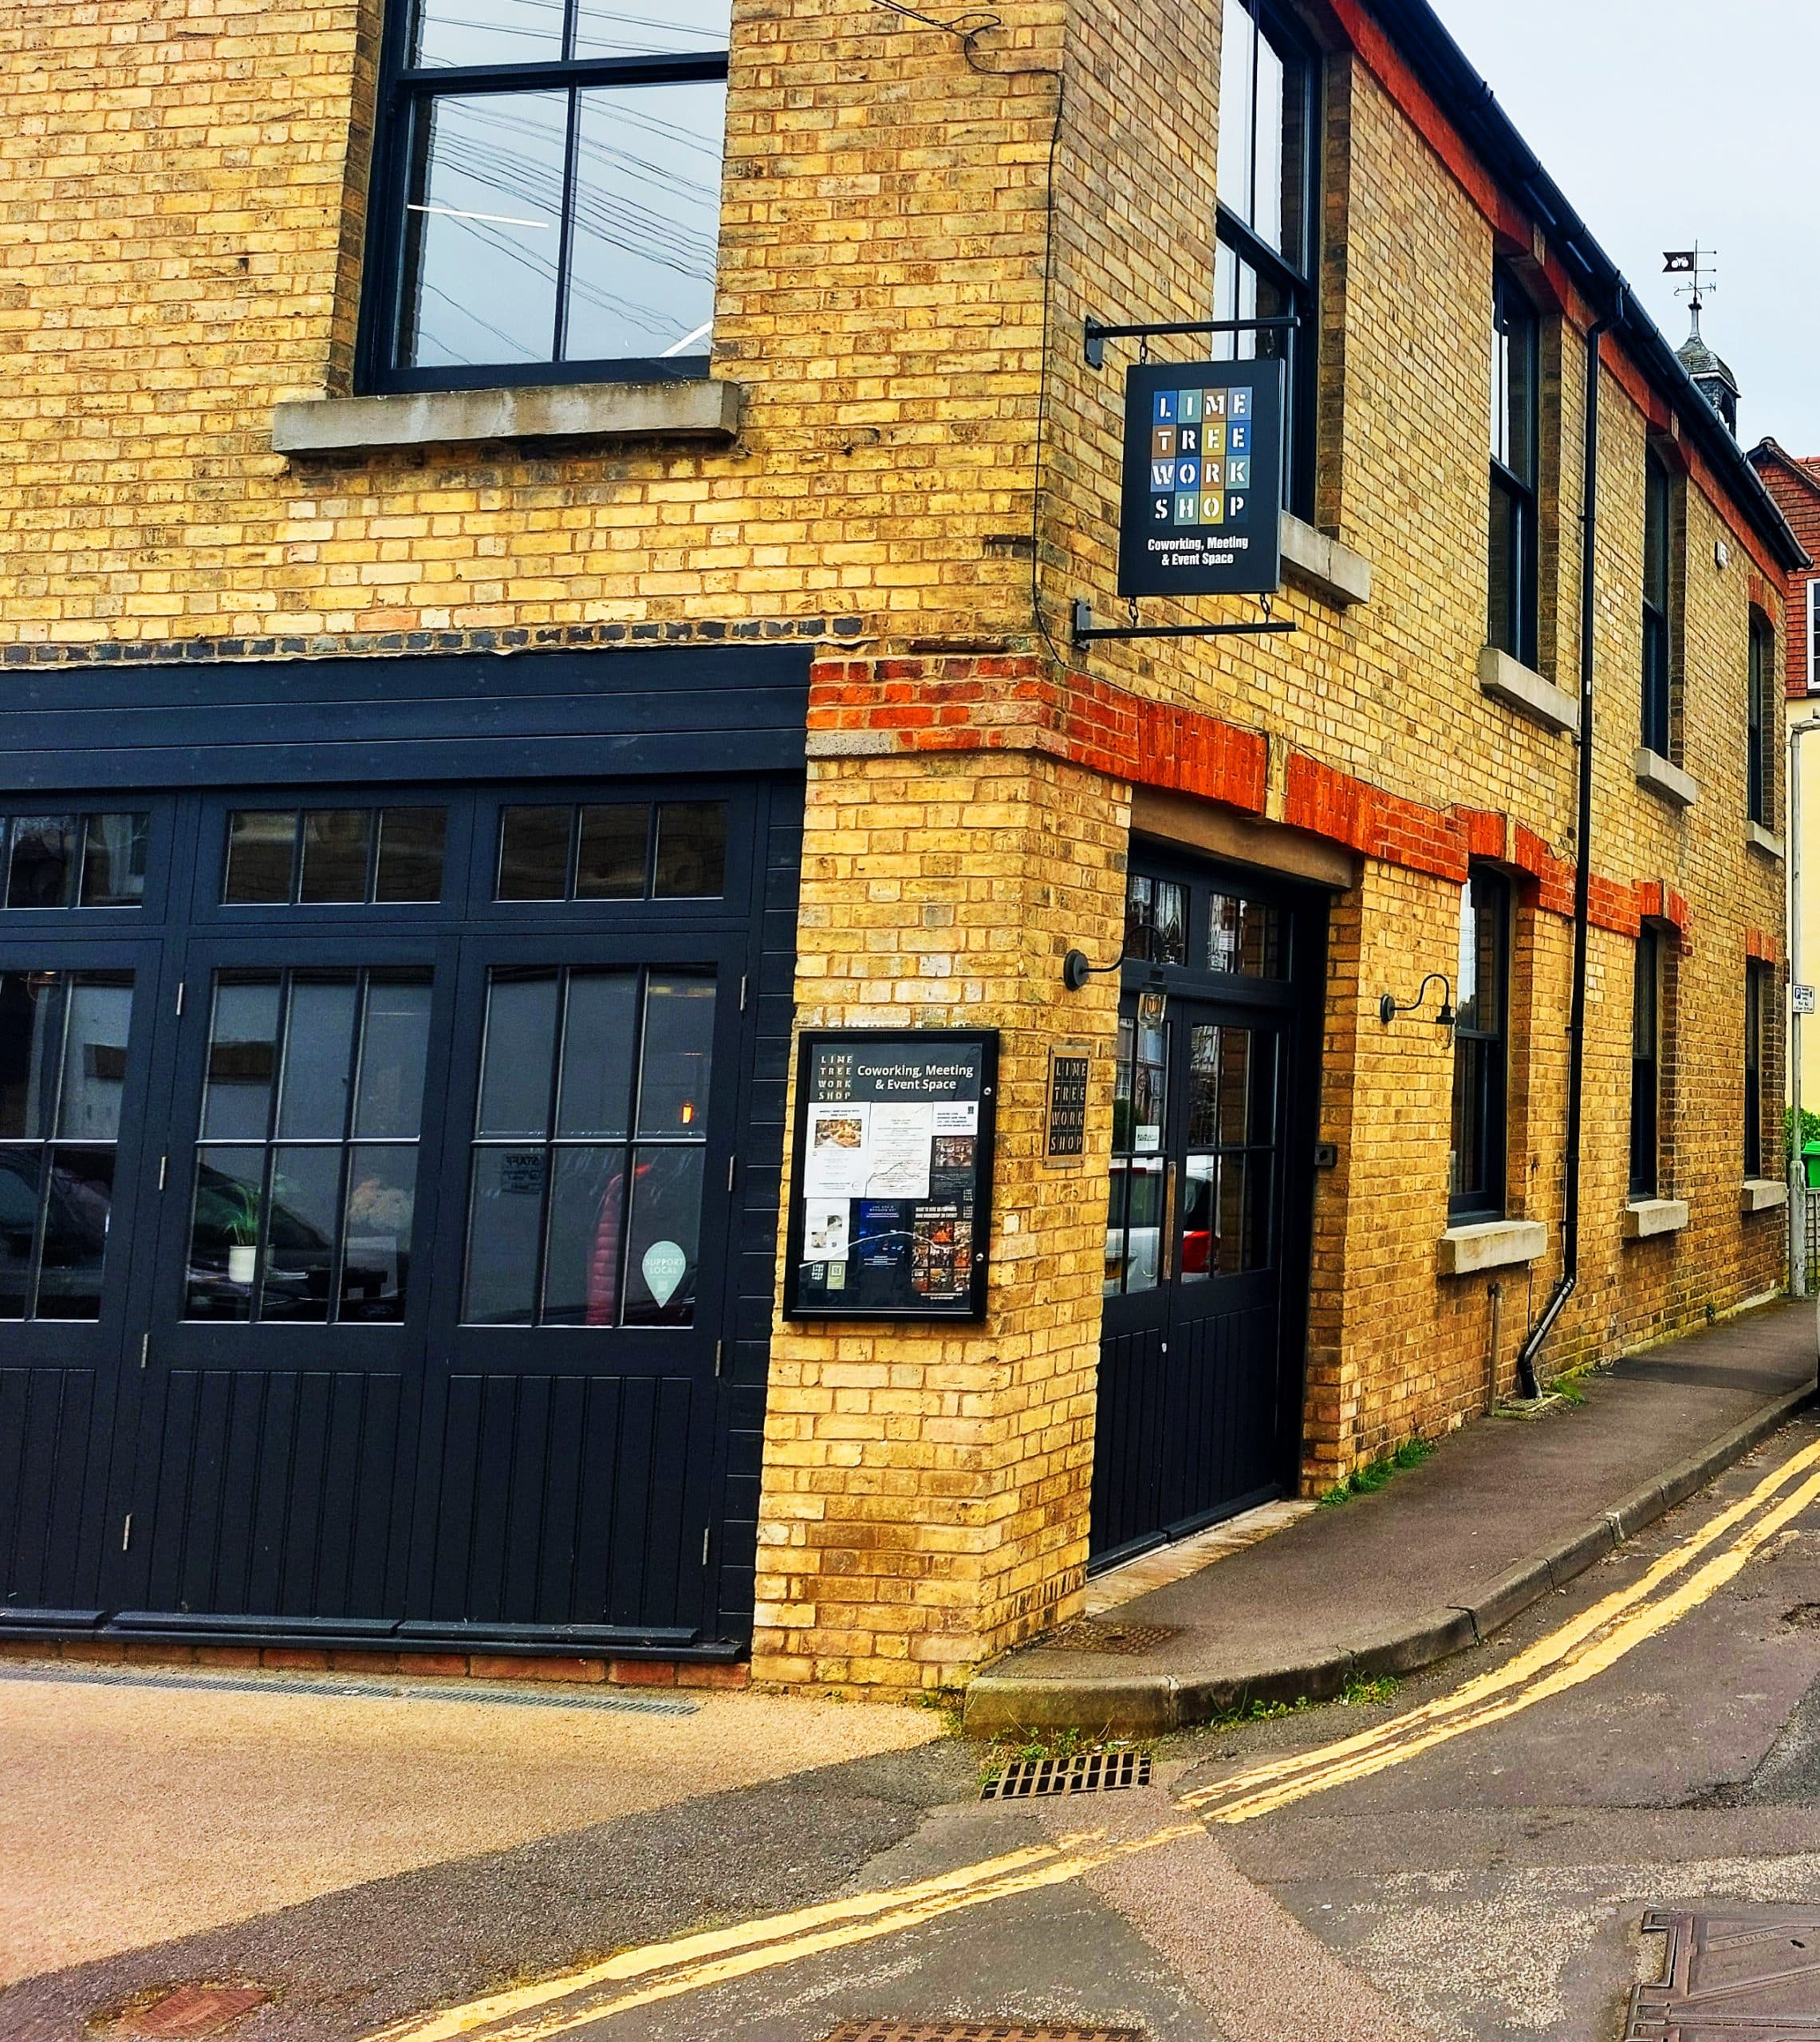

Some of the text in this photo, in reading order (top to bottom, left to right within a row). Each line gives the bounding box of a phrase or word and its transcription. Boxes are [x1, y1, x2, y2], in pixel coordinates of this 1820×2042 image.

[1159, 393, 1247, 418] LIME
[1157, 427, 1245, 451] TREE
[1151, 461, 1246, 486] WORK
[1154, 495, 1244, 519] SHOP
[1148, 535, 1248, 551] Coworking, Meeting
[1161, 552, 1234, 566] & Event Space
[820, 1066, 852, 1075] TREE
[857, 1064, 974, 1078] Coworking, Meeting
[1055, 1062, 1086, 1077] LIME
[875, 1079, 957, 1092] & Event Space
[818, 1091, 851, 1101] SHOP
[1054, 1086, 1085, 1101] TREE
[1051, 1111, 1084, 1126] WORK
[1050, 1136, 1082, 1151] SHOP
